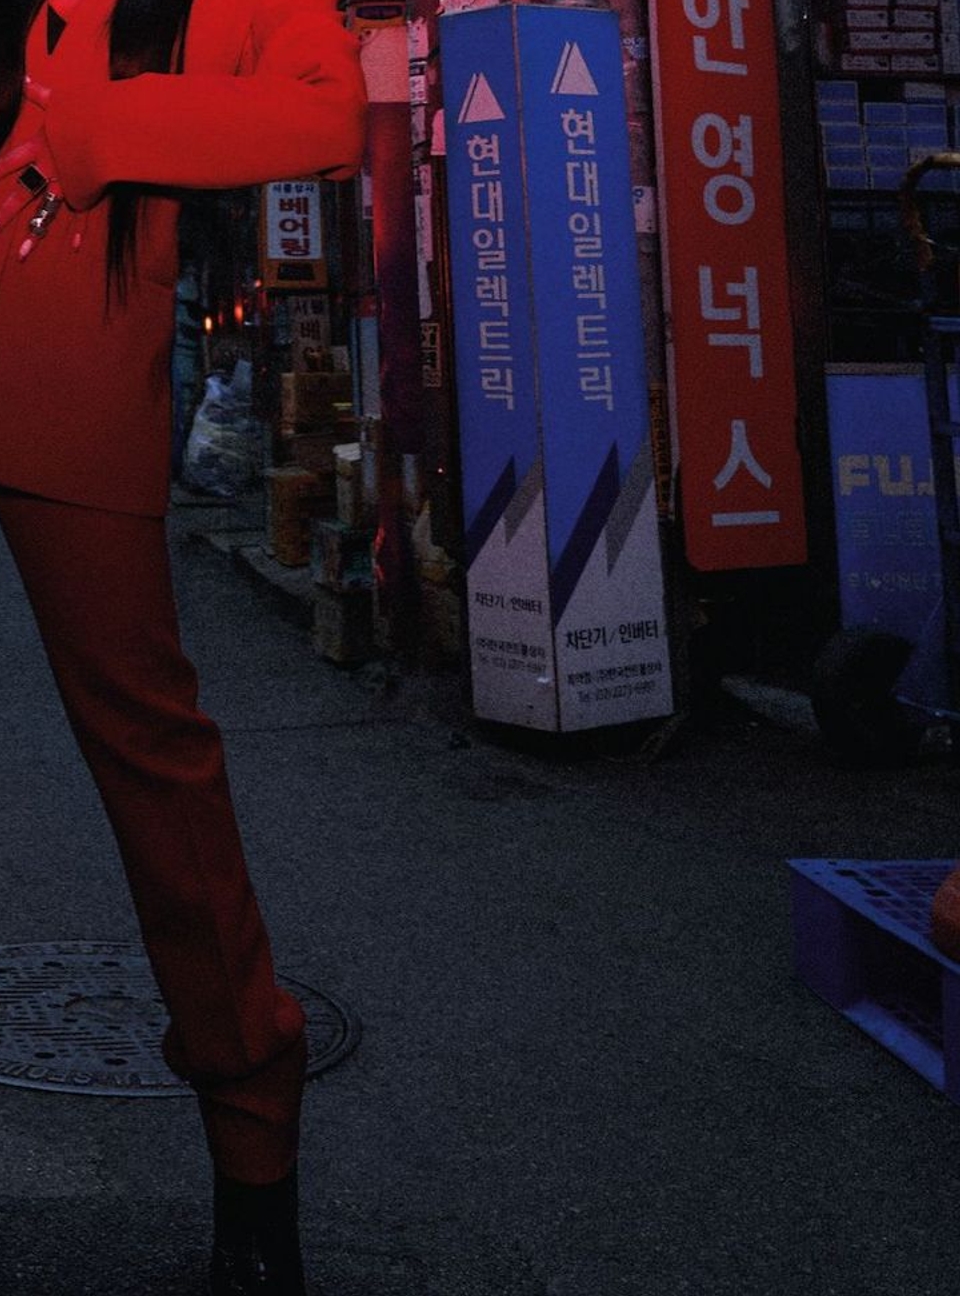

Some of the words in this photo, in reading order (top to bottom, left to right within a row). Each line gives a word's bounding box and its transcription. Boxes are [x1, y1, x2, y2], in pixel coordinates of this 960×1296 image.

[466, 133, 515, 410] 현대일렉트릭
[560, 108, 614, 411] 현대일렉트릭
[566, 626, 607, 651] 차단기
[618, 619, 660, 644] 인버터
